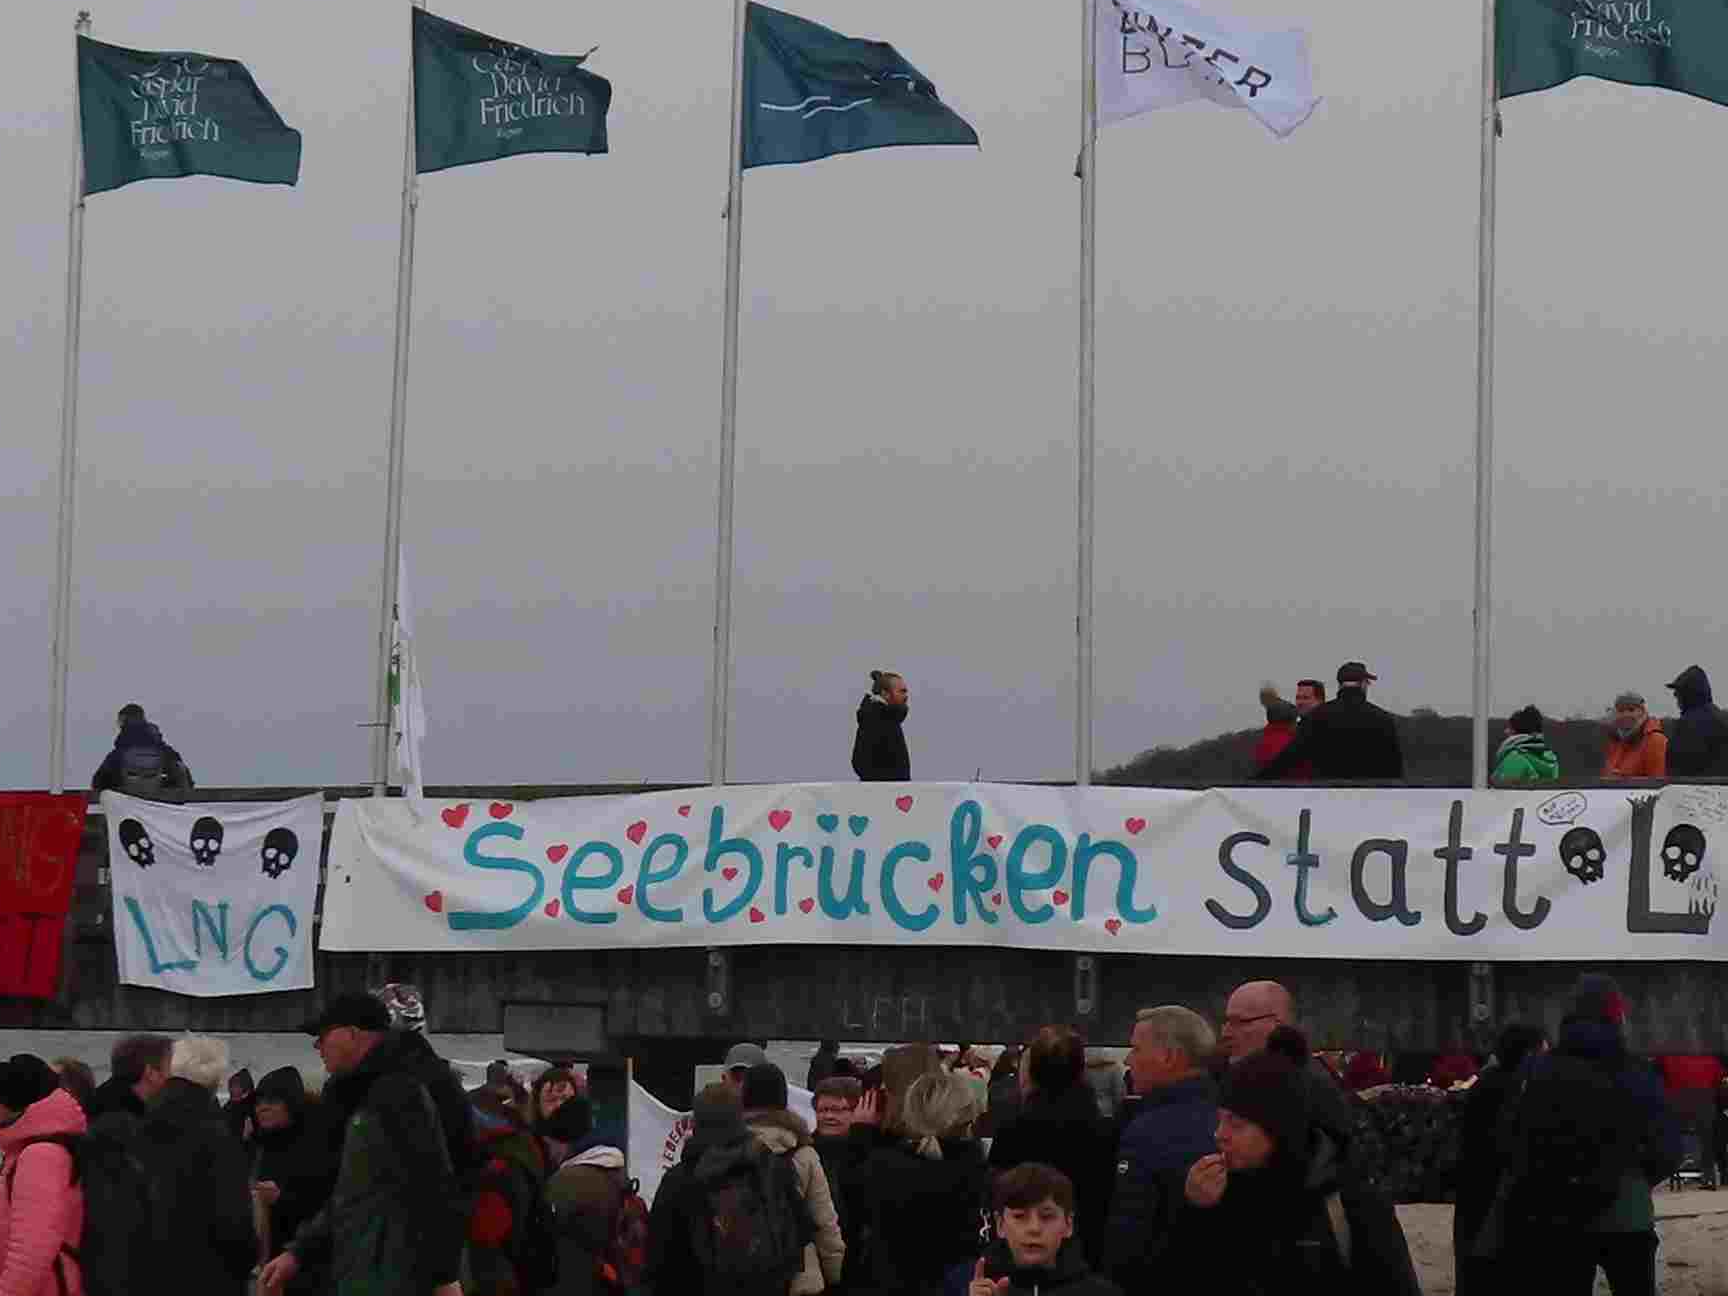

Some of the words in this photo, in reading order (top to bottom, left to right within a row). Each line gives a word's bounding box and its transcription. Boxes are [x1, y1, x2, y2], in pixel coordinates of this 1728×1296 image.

[129, 119, 222, 145] Frierich
[479, 91, 585, 126] Friedrich
[447, 798, 1159, 933] Seebrücken
[125, 895, 298, 982] LNG
